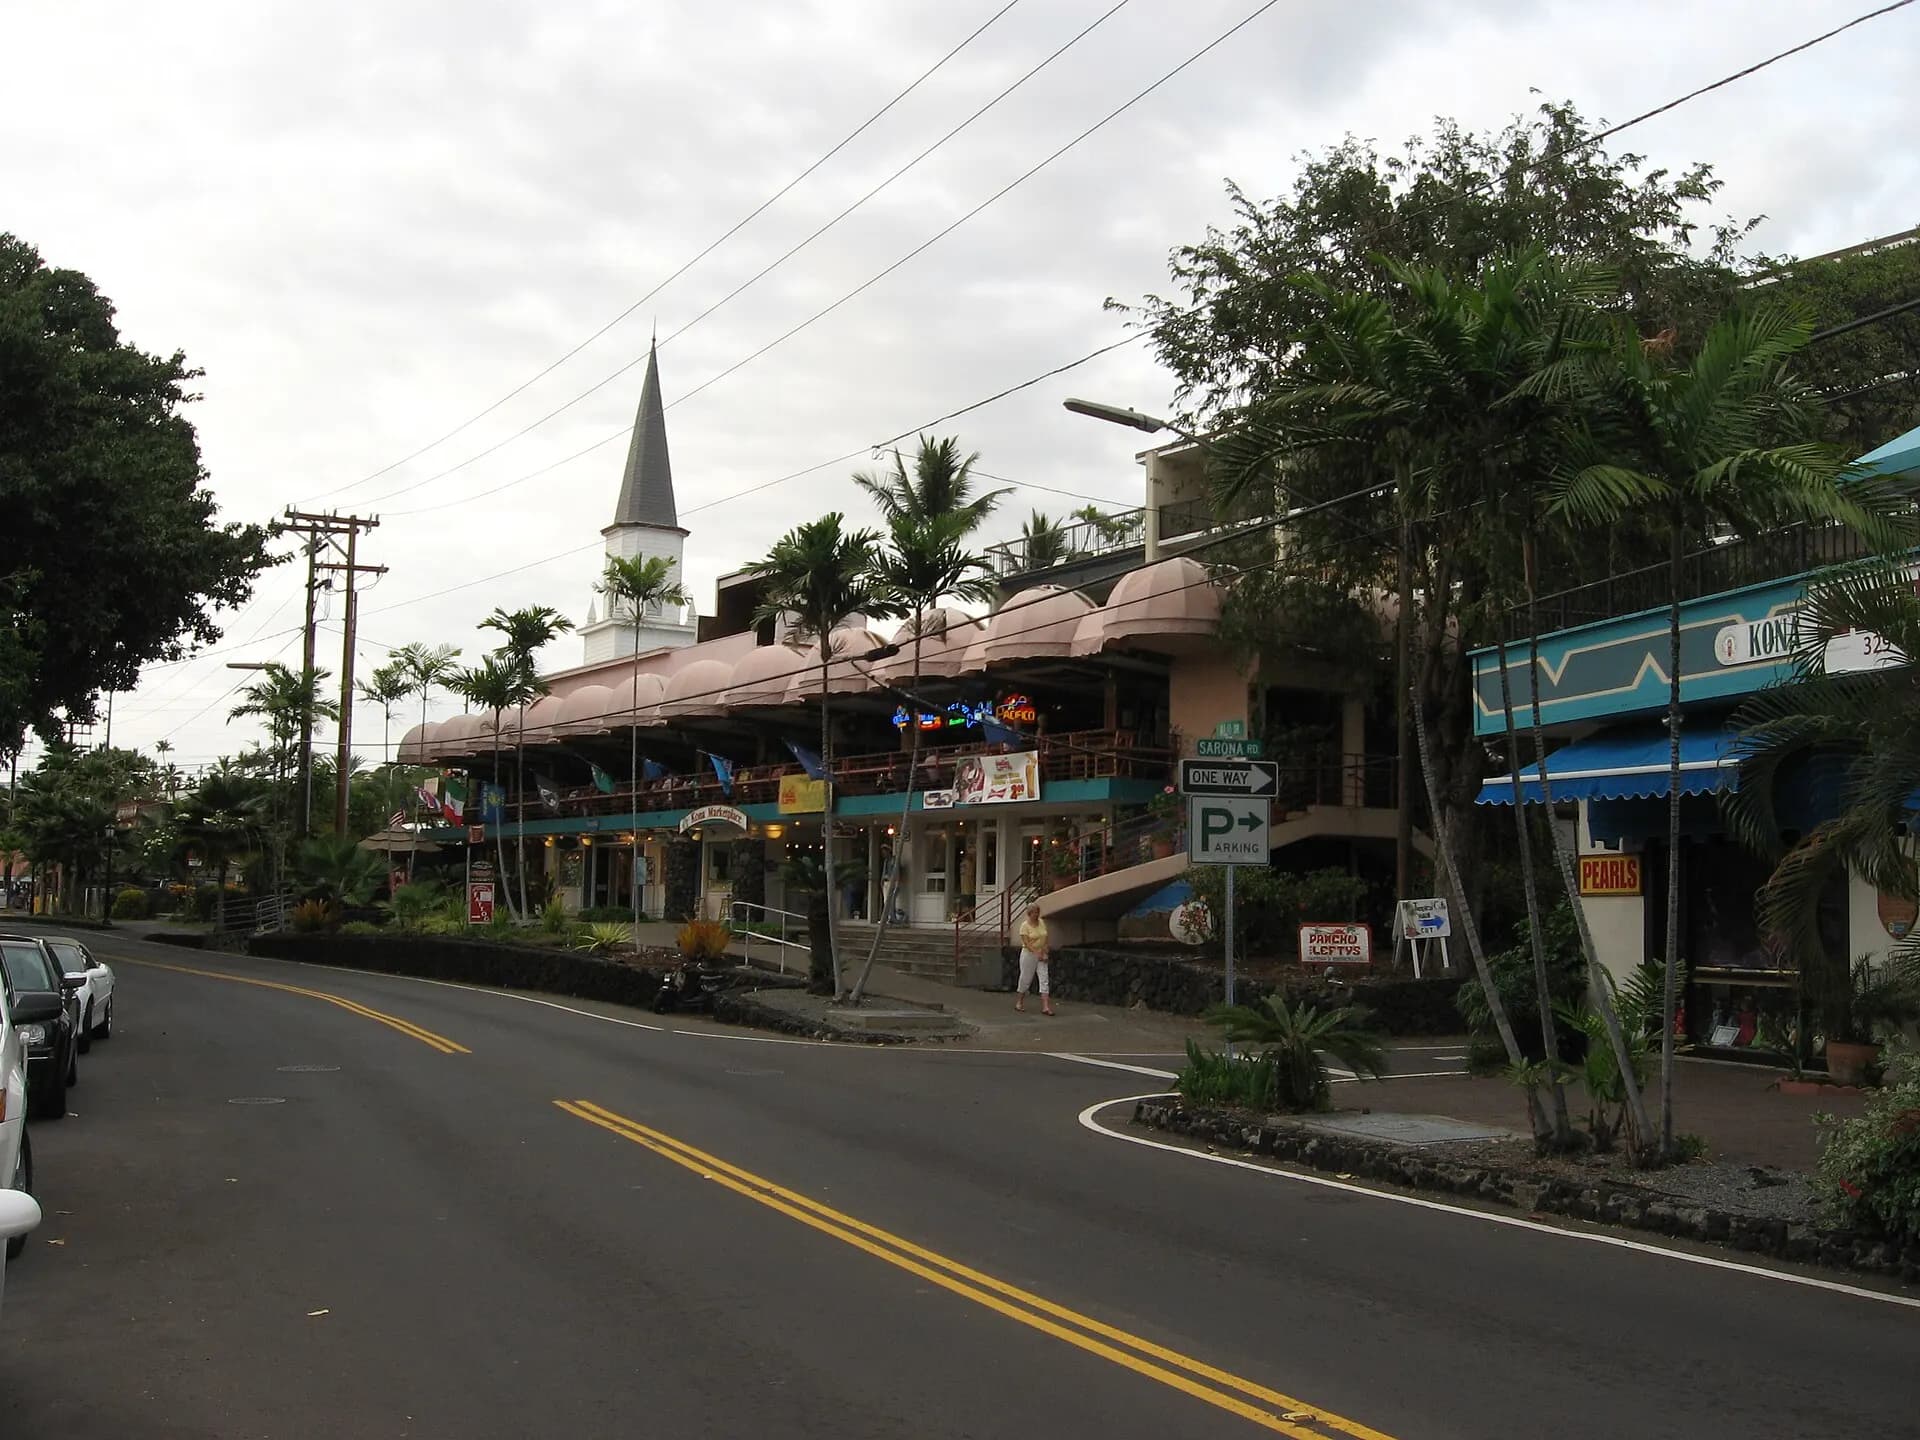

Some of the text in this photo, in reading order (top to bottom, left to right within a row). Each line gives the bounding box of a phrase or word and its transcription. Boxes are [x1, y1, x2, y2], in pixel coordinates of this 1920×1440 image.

[1199, 741, 1243, 755] SARONA
[1192, 770, 1249, 785] ONE WAY
[1582, 860, 1638, 889] PEARLS
[1309, 934, 1357, 945] PANCHO
